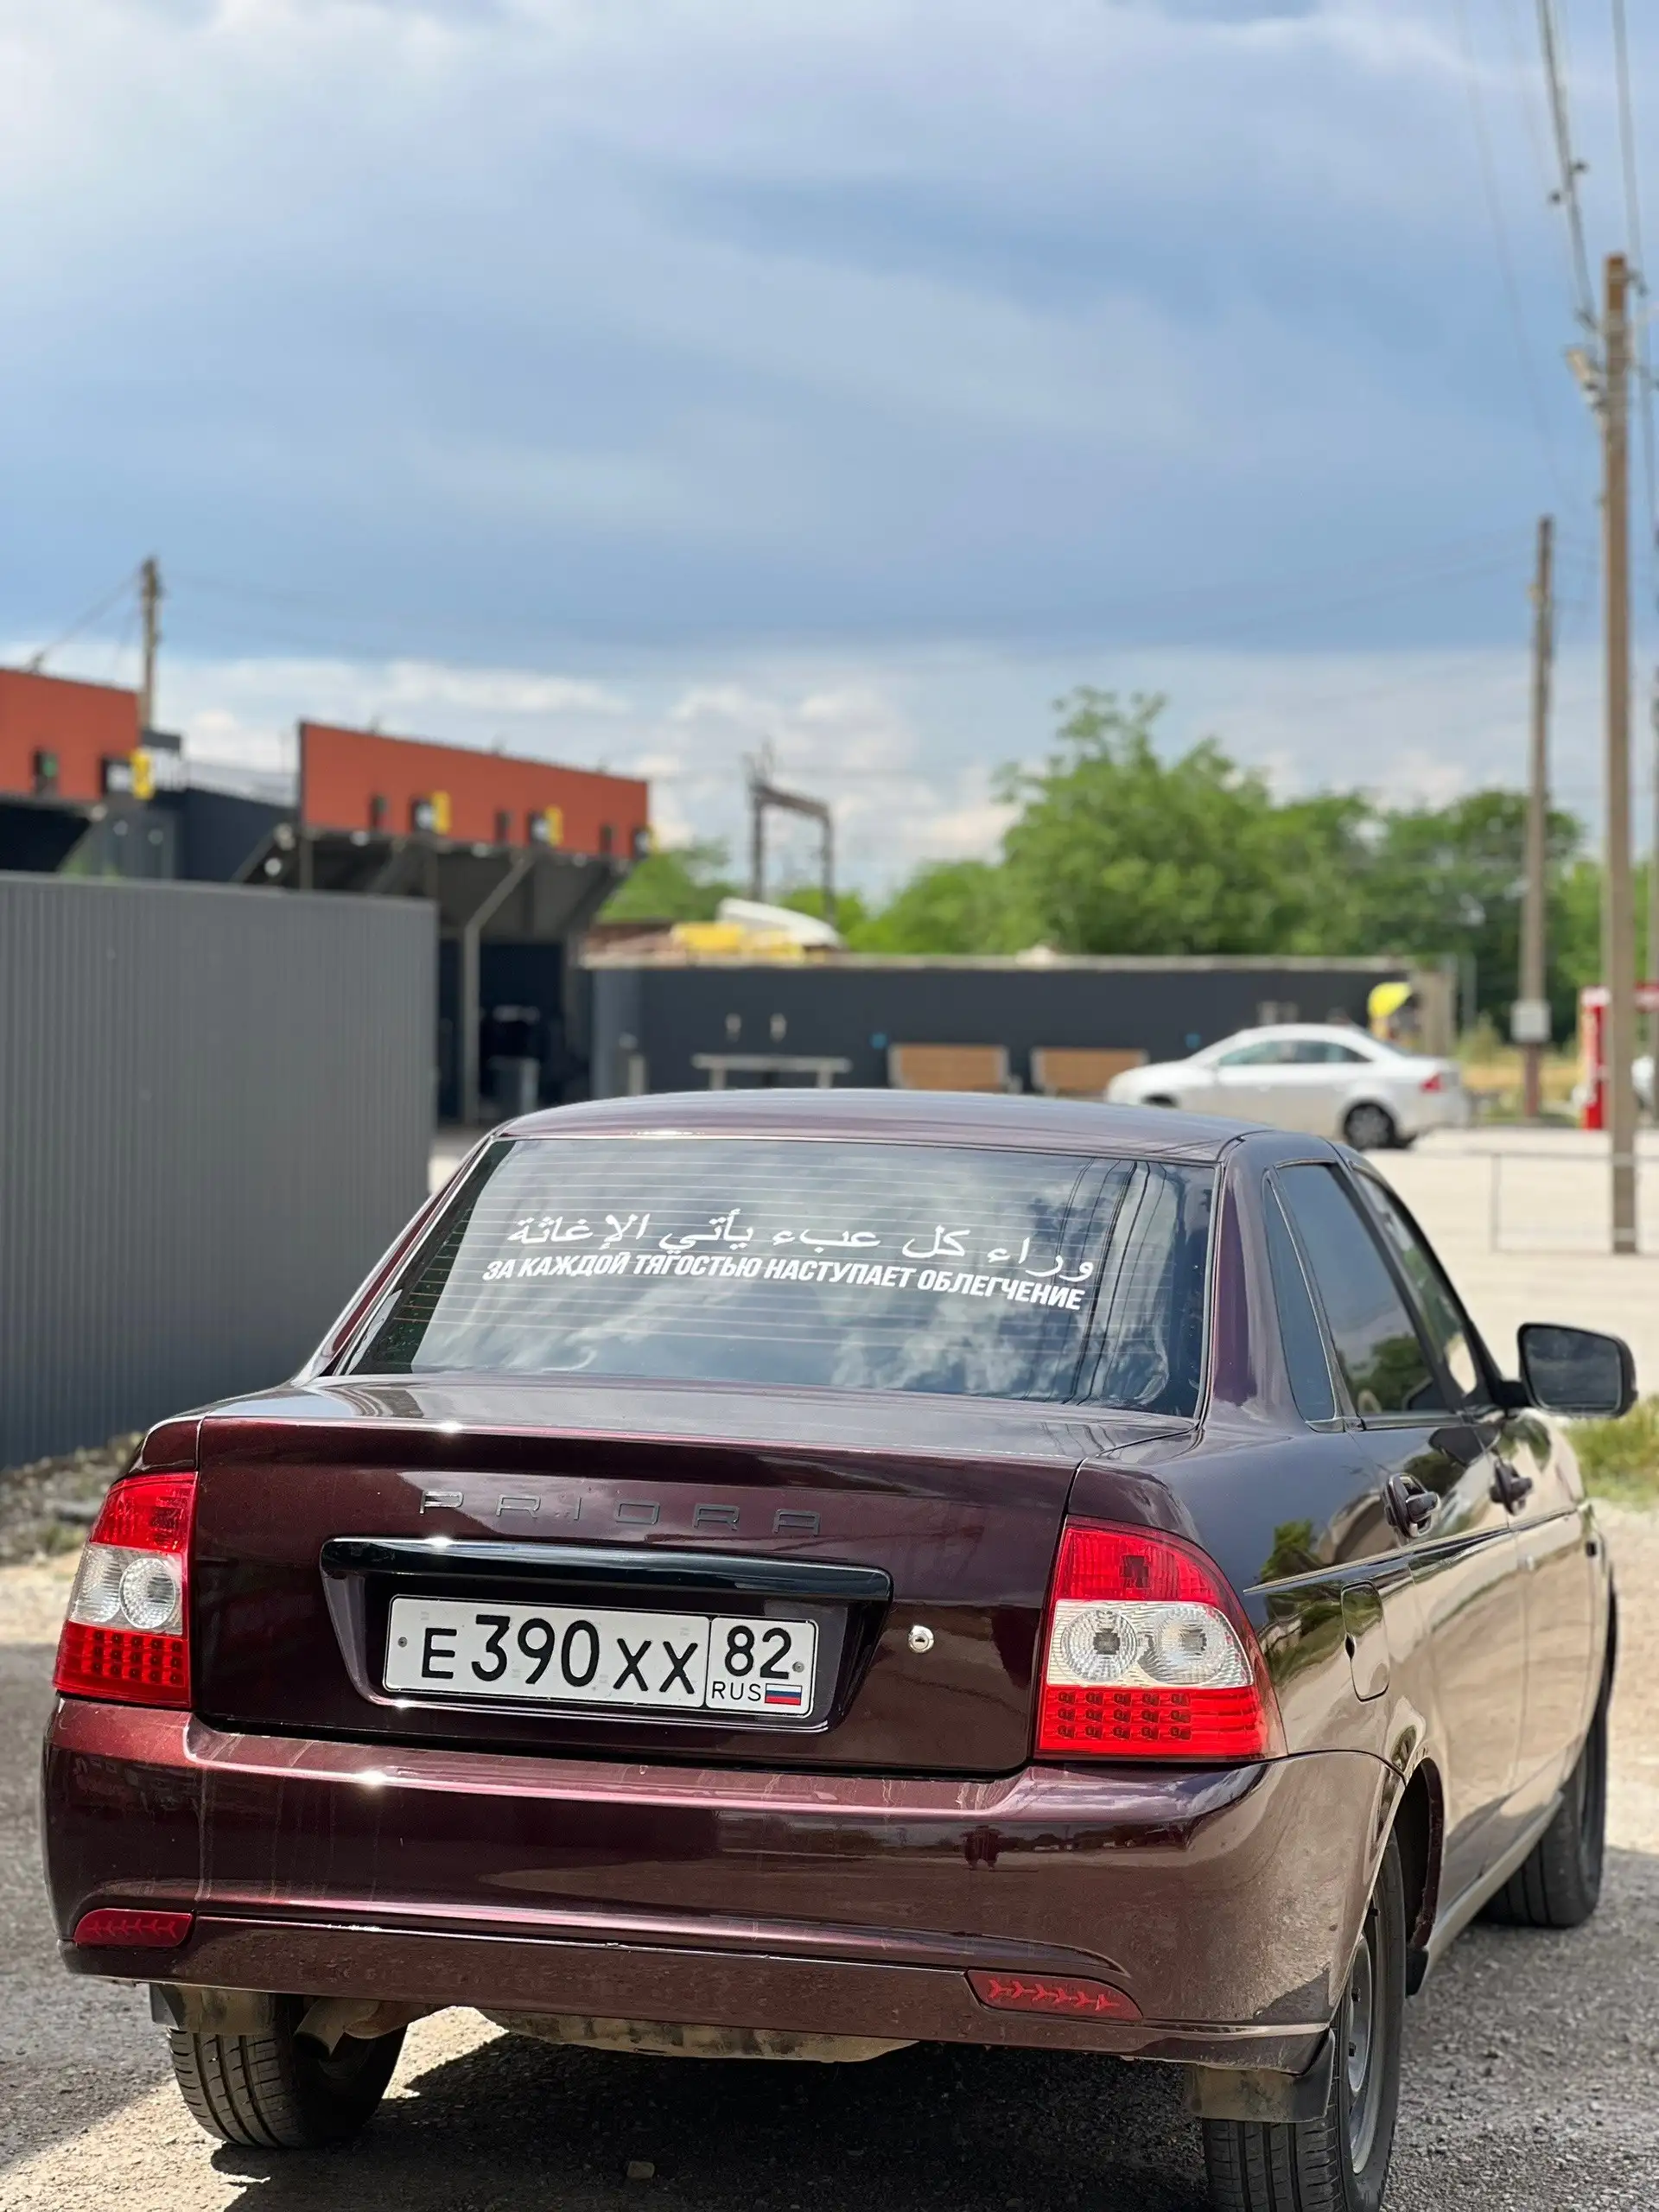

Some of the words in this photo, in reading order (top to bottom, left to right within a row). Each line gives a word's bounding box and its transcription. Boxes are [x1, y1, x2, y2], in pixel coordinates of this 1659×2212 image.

[901, 1224, 970, 1258] كل
[482, 1258, 516, 1281] ЗА
[517, 1251, 632, 1277] КАЖДОЙ
[632, 1255, 763, 1279] ТЯГОСТЬЮ
[763, 1258, 917, 1287] НАСТУПАЕТ
[917, 1269, 1085, 1310] ОБЛЕГЧЕНИЕ
[419, 1490, 821, 1536] PRIORA
[724, 1624, 791, 1680] 82
[711, 1681, 761, 1702] RUS
